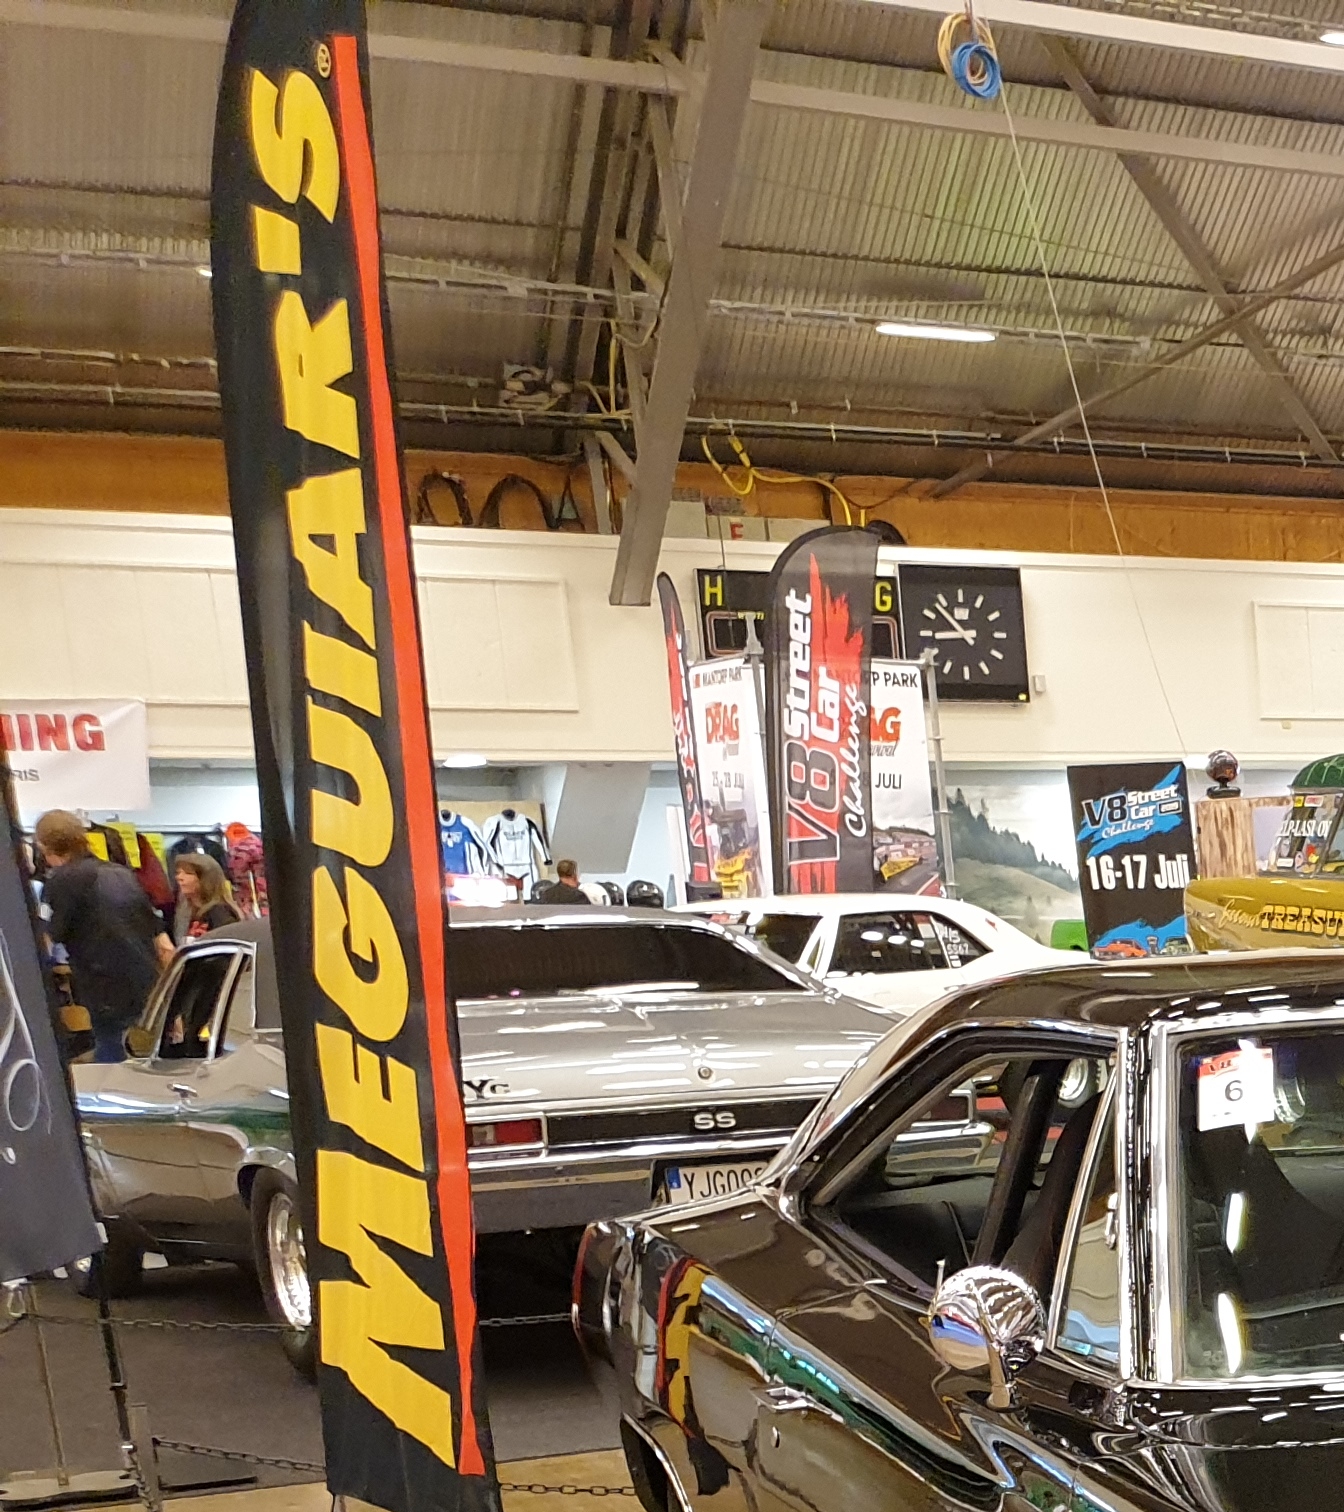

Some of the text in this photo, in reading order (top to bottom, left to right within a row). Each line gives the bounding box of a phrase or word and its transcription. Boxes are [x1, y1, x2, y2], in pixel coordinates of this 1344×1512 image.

[704, 575, 723, 606] H
[784, 587, 812, 741] Street
[884, 672, 918, 688] PARK
[811, 666, 842, 743] Car
[250, 67, 456, 1469] MEGUIAR'S
[875, 773, 902, 790] JULI
[1081, 783, 1179, 829] V8 Street
[1130, 805, 1156, 820] Car
[1086, 854, 1190, 890] 16-17 Juli
[1225, 1080, 1243, 1101] 6
[694, 1112, 737, 1131] SS
